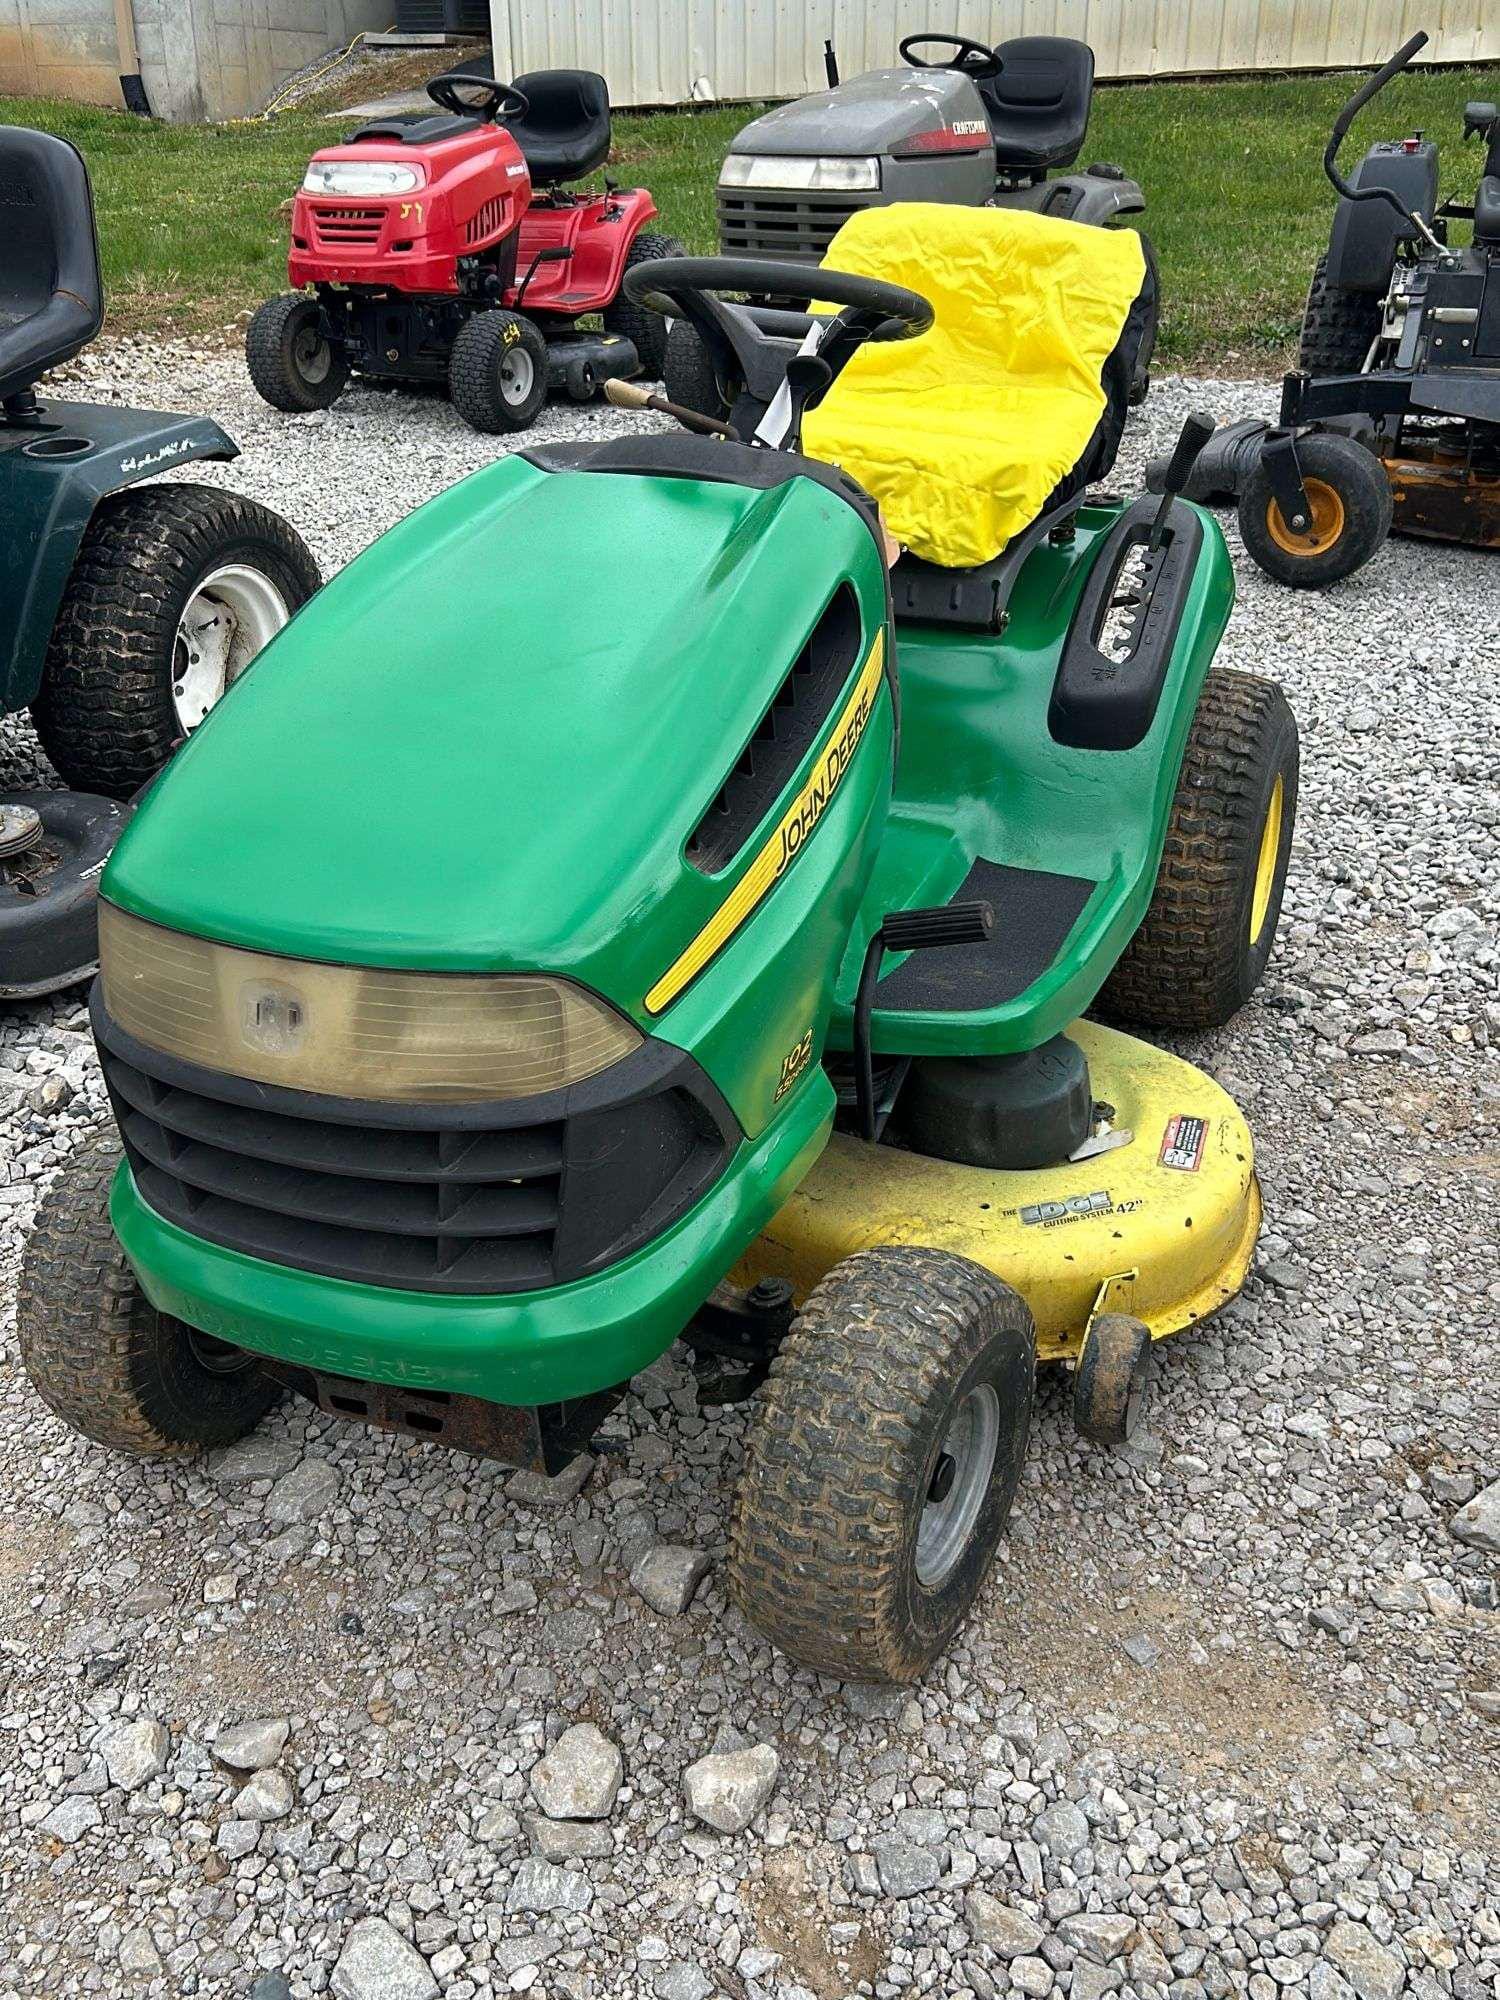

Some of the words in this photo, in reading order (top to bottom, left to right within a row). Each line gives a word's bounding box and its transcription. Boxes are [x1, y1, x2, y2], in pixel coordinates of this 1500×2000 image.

[777, 776, 826, 874] JOHN
[826, 687, 870, 793] DEERE
[782, 1028, 813, 1079] 102
[1002, 1208, 1018, 1217] THE
[1019, 1191, 1112, 1225] EDGE
[1043, 1214, 1079, 1229] CUTTING
[1080, 1208, 1114, 1221] SYSTEM
[286, 1336, 440, 1385] DEERE
